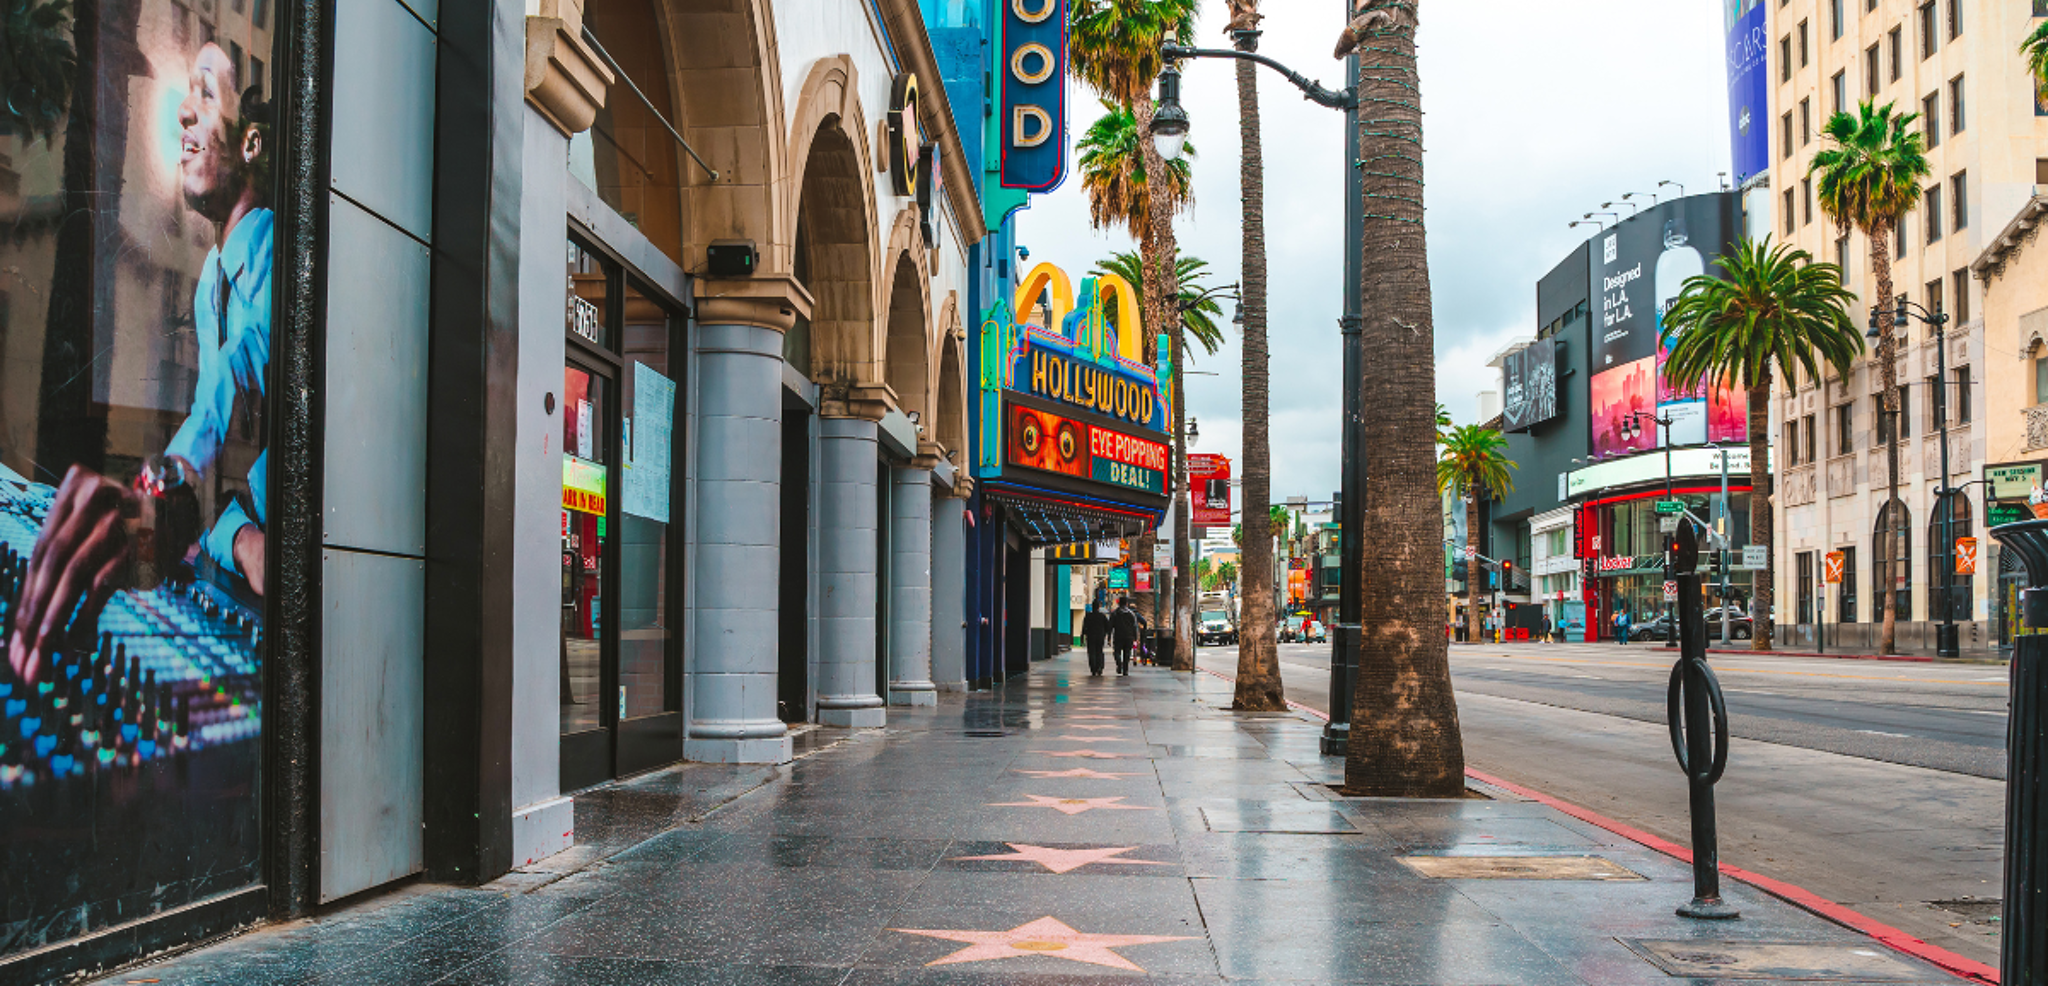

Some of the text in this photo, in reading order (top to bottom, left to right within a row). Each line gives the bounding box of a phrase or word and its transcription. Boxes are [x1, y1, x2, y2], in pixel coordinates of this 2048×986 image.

[1604, 262, 1641, 292] Designed
[1604, 296, 1612, 311] in
[1604, 311, 1615, 328] for
[1031, 349, 1153, 424] HOLLYWOOD
[1091, 427, 1114, 458] EYE
[1115, 434, 1165, 470] POPPING
[1110, 461, 1150, 489] DEAL!
[562, 487, 577, 508] ARK
[588, 493, 605, 514] REAR
[1575, 510, 1583, 537] Locker
[1601, 554, 1632, 571] Locker
